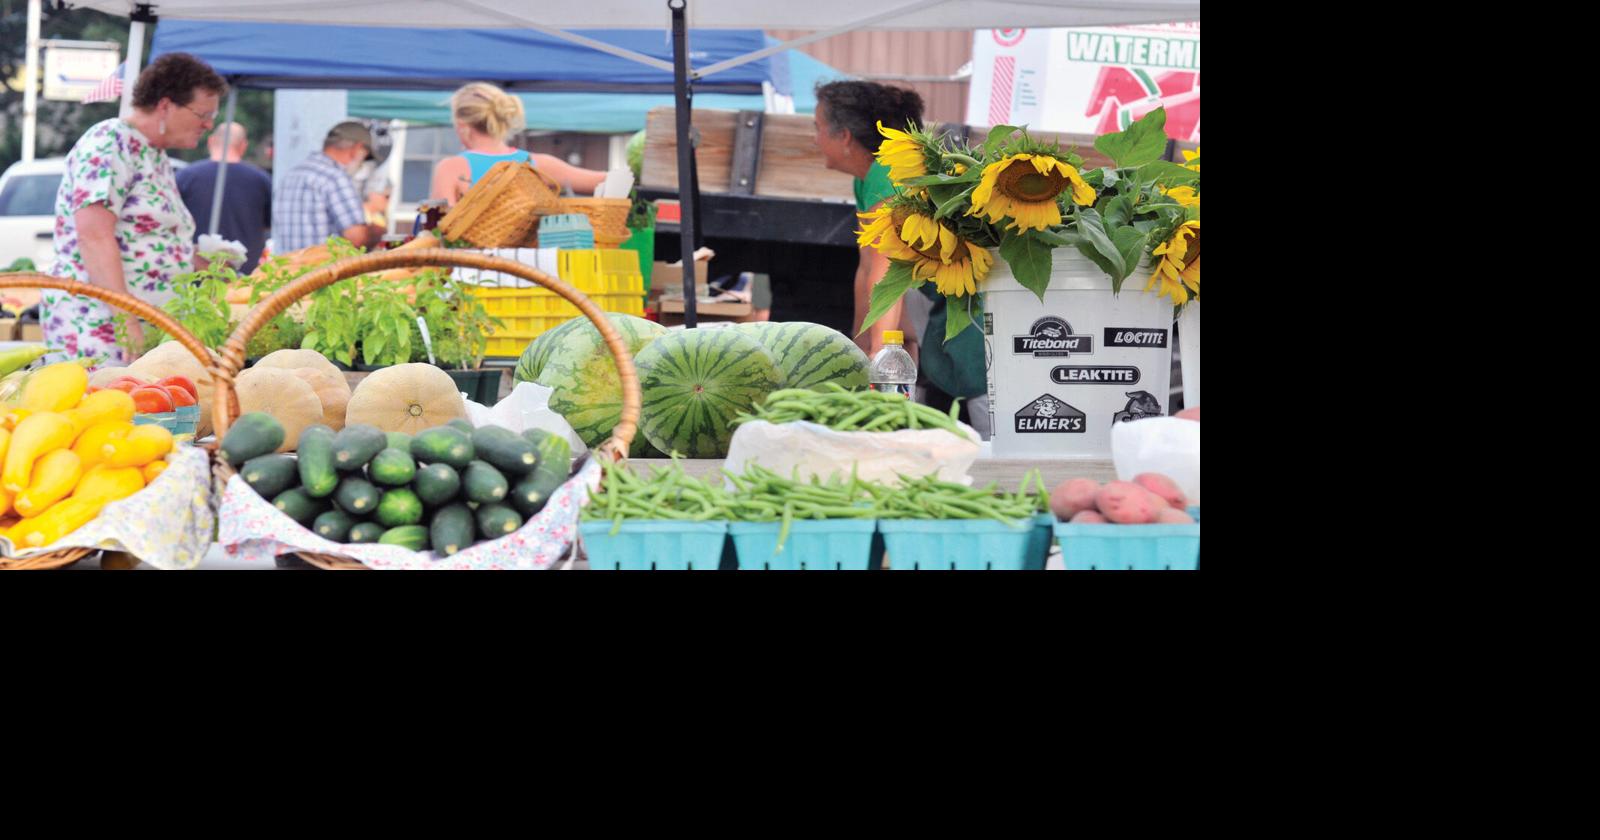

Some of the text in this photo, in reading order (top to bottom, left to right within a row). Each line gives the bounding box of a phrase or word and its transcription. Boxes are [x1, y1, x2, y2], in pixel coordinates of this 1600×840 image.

[1067, 31, 1200, 69] WATERM
[1022, 338, 1080, 349] Titebond
[1114, 331, 1164, 344] LOCTITE
[1059, 369, 1133, 381] LEAKTITE
[1018, 417, 1081, 430] ELMER'S
